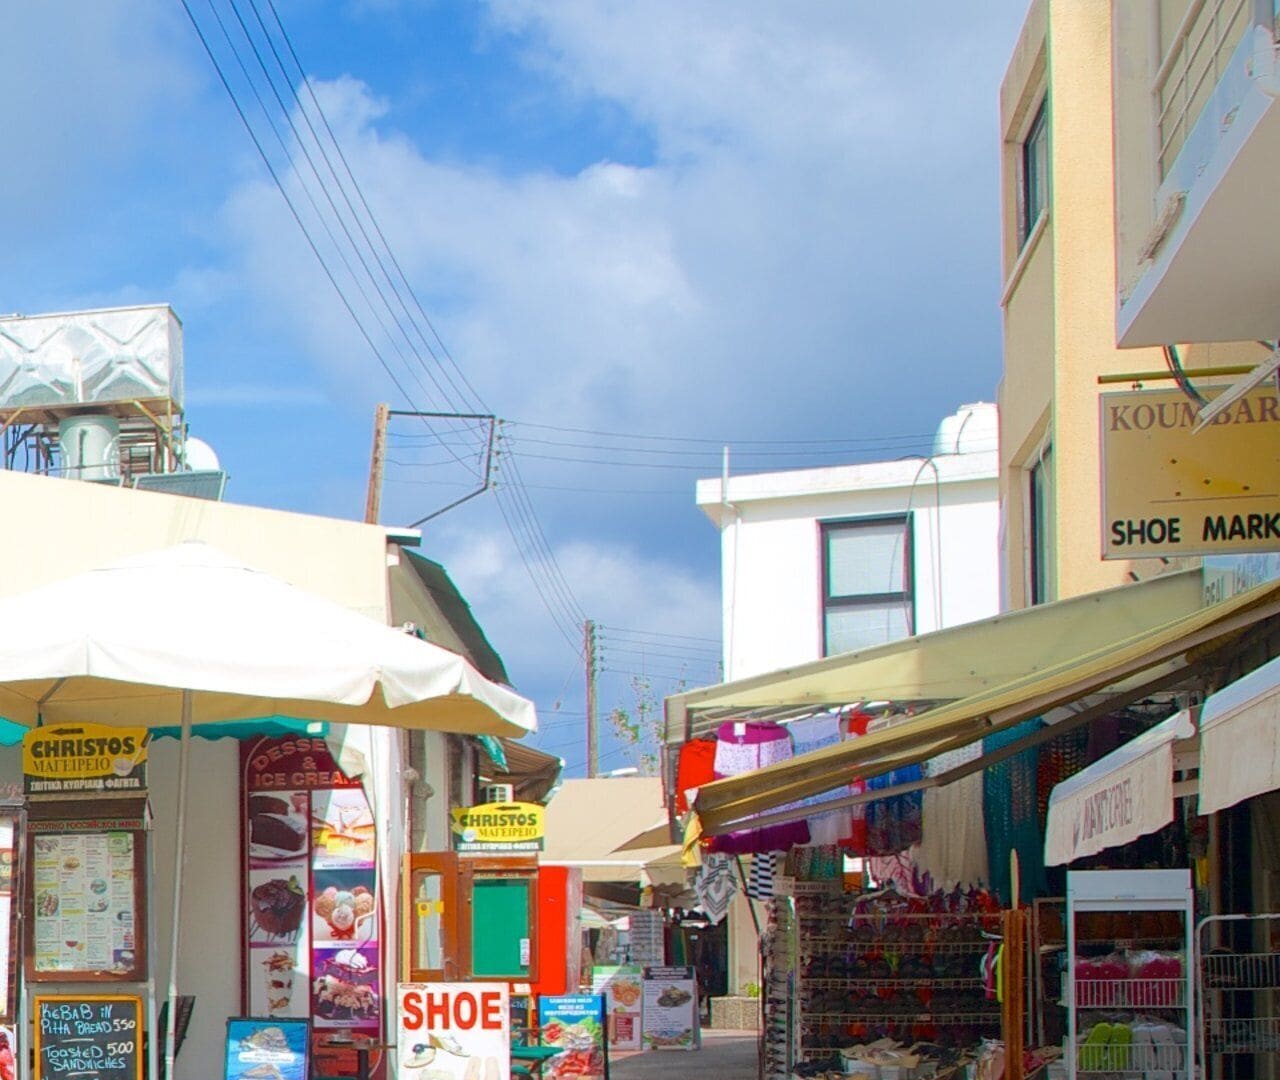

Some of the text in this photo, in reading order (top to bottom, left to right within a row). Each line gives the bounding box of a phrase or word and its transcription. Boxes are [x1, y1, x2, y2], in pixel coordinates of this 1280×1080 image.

[1111, 513, 1280, 546] SHOE MARK
[31, 736, 135, 758] CHRISTOS
[302, 756, 317, 770] &
[256, 771, 361, 787] ICE CREA
[460, 813, 537, 827] CHRISTOS
[403, 992, 502, 1030] SHOE
